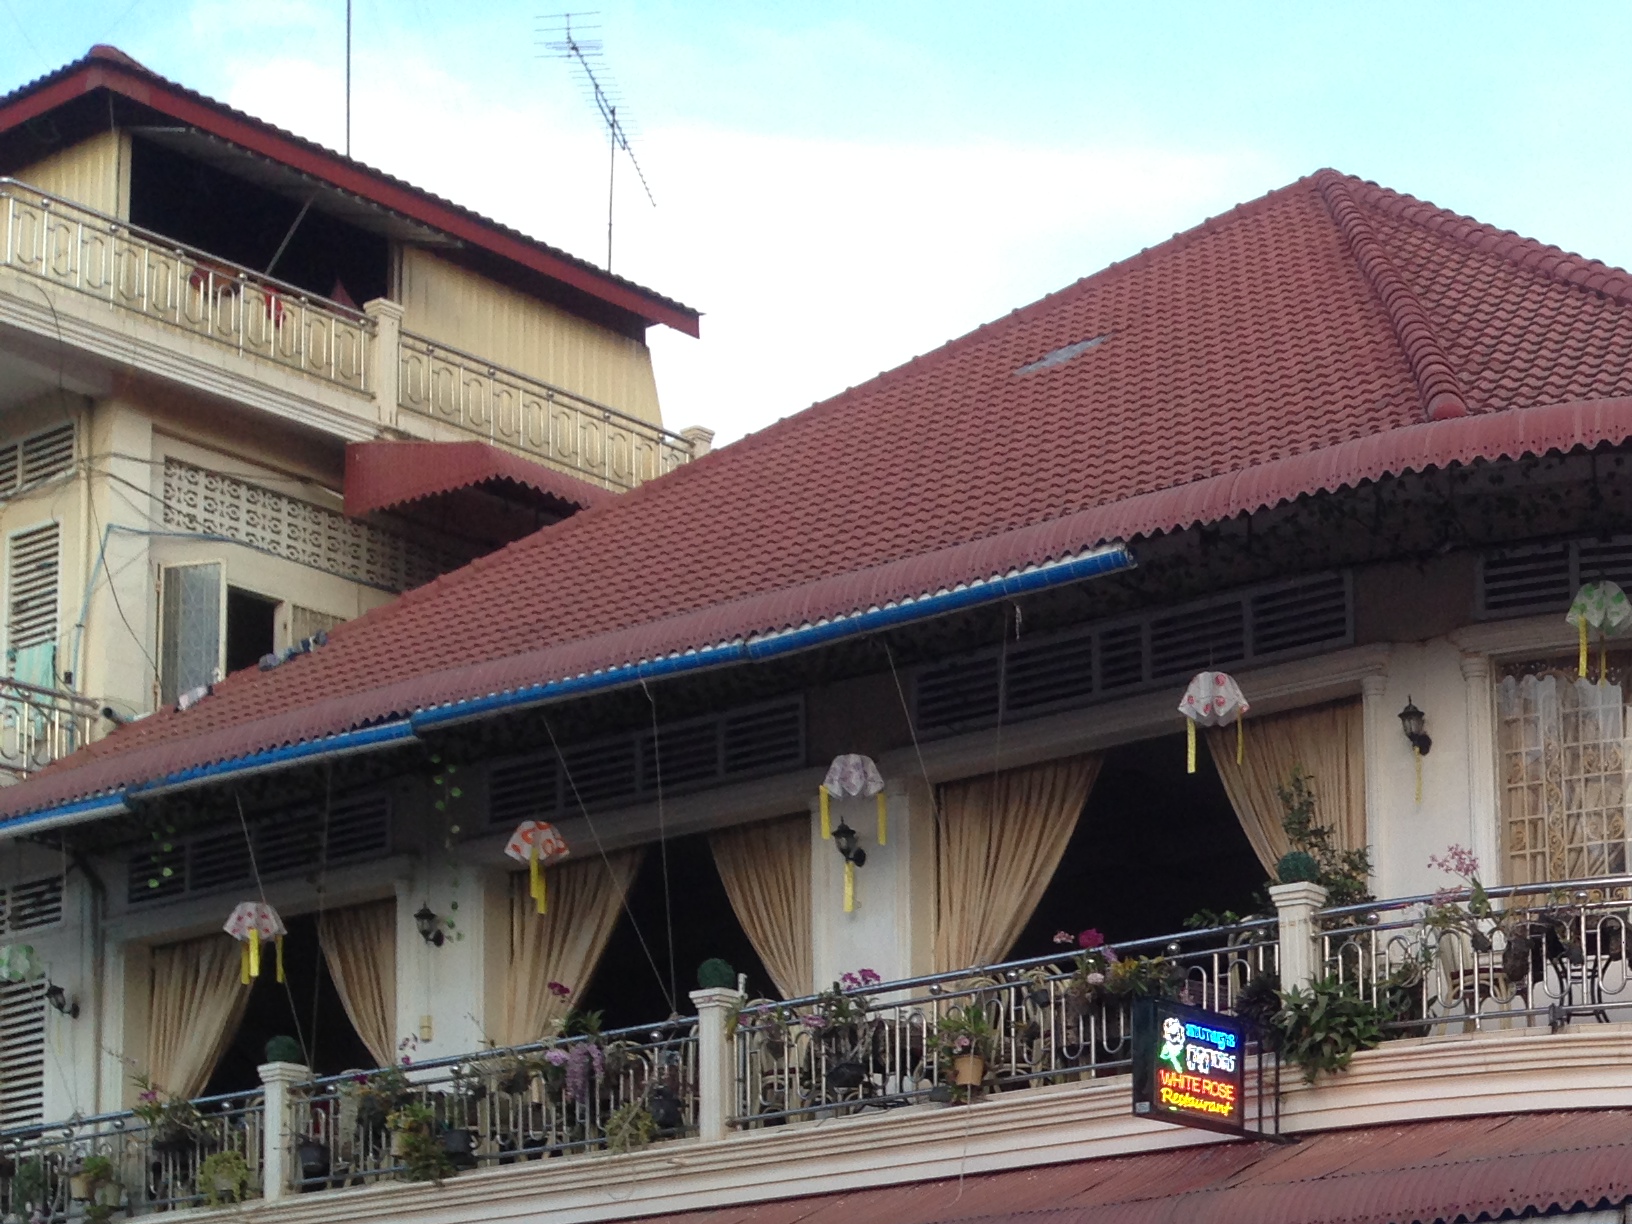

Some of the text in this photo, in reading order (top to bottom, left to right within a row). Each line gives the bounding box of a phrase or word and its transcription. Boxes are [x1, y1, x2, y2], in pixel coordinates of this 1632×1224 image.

[1159, 1069, 1235, 1101] WHITE ROSE
[1160, 1087, 1233, 1116] Restaurant
